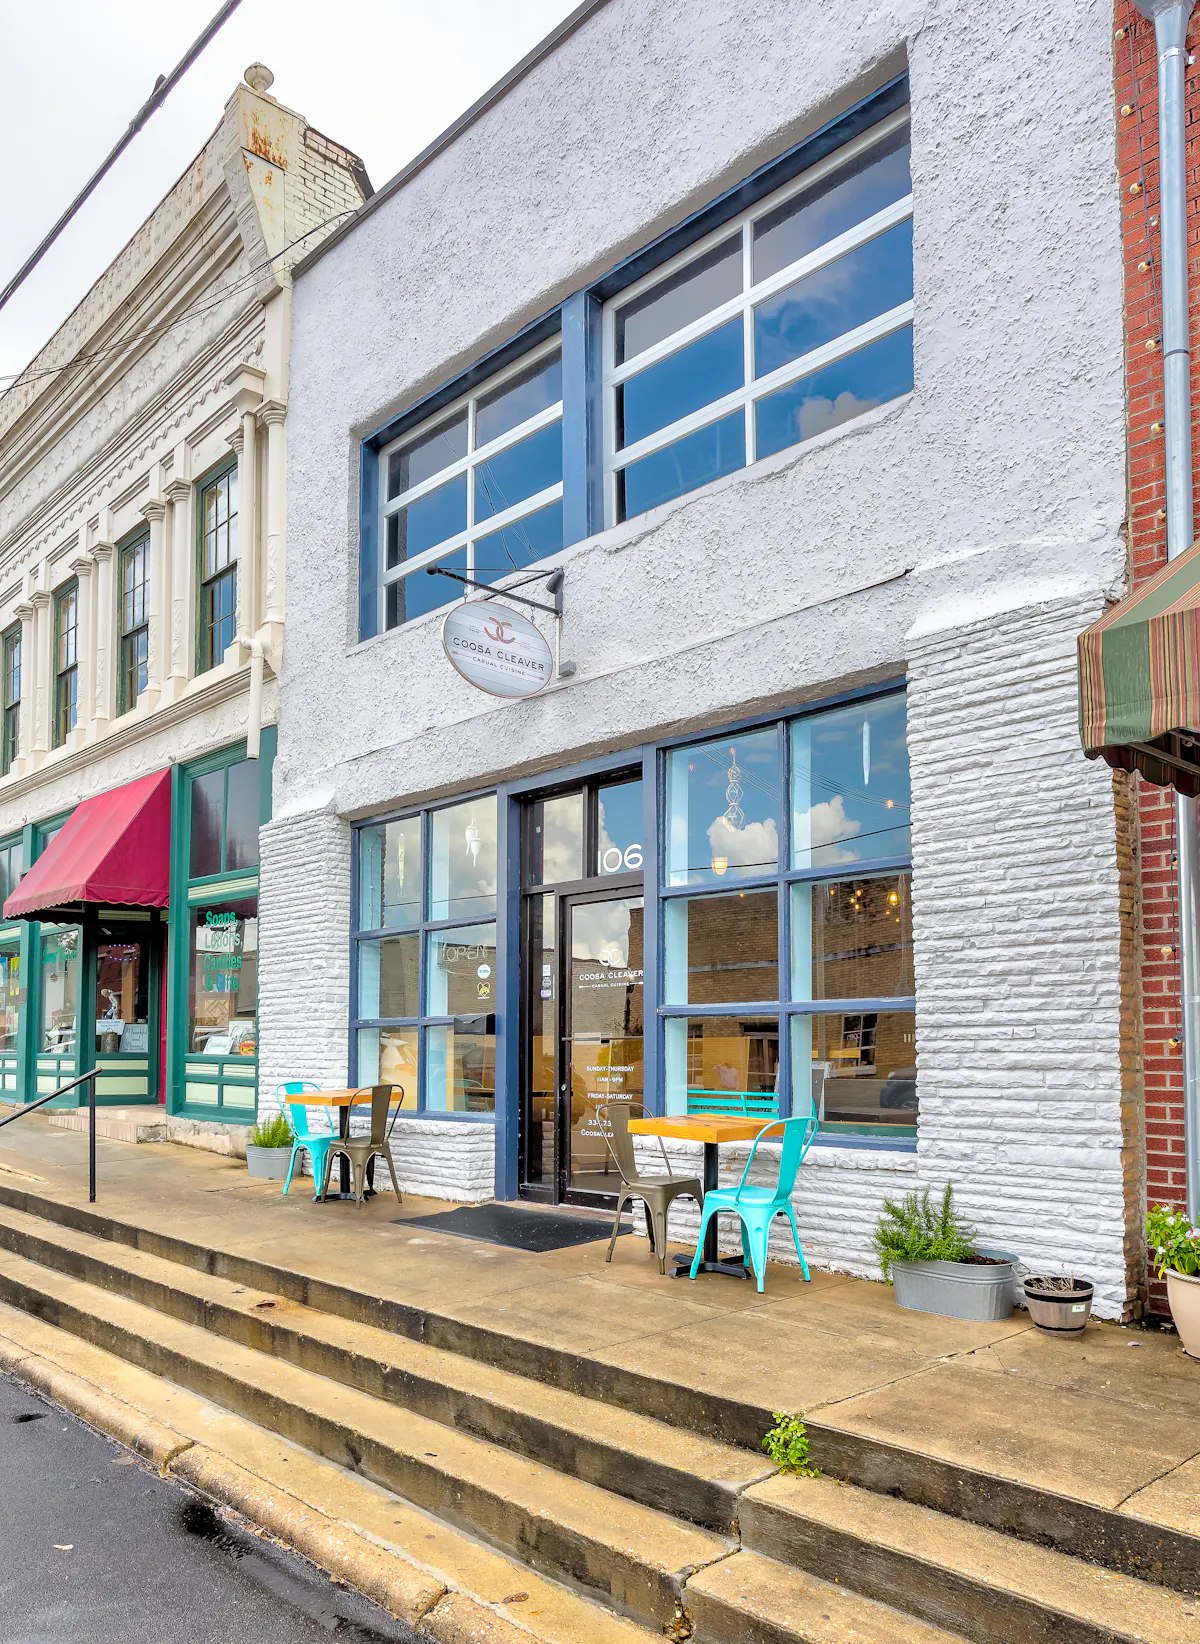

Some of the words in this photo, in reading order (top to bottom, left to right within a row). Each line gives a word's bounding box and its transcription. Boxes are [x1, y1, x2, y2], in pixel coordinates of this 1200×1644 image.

[453, 637, 491, 655] COOSA
[496, 650, 545, 671] CLEAVER
[472, 656, 497, 668] CASUAL
[499, 664, 526, 676] CUISINE
[597, 843, 643, 873] 106
[204, 931, 243, 949] Lotions,
[203, 954, 242, 971] Candles
[446, 944, 488, 962] OPEN
[205, 974, 213, 991] &
[216, 972, 239, 992] Gifts
[579, 972, 605, 981] COOSA
[608, 969, 644, 979] CLEAVER
